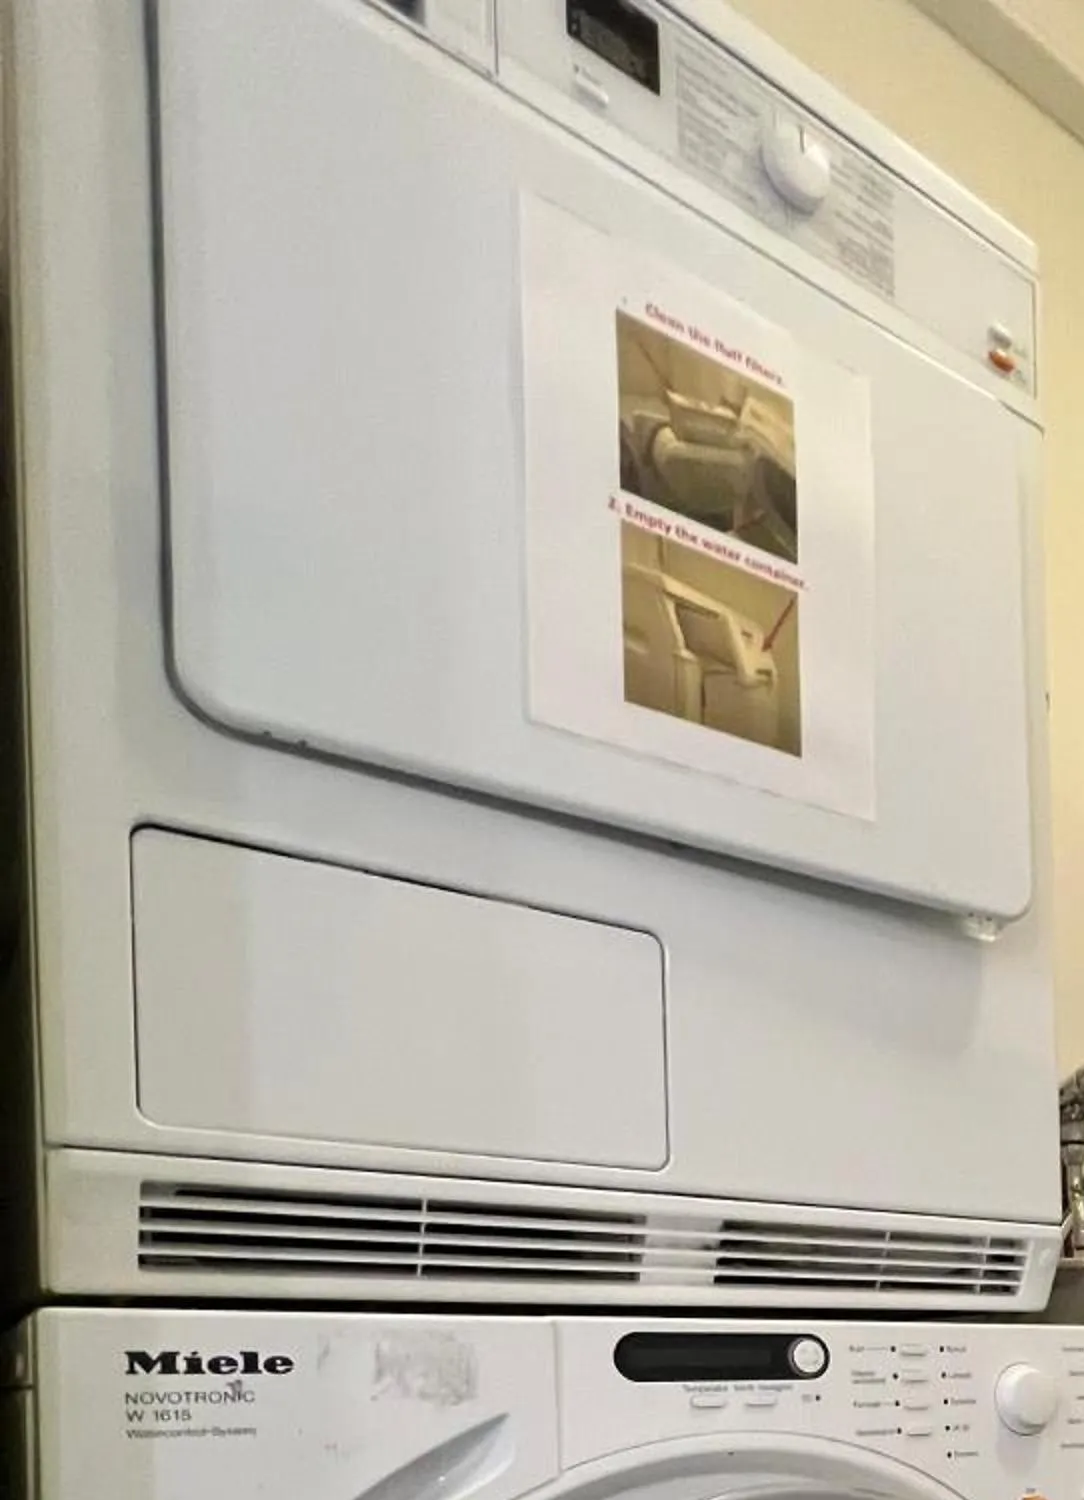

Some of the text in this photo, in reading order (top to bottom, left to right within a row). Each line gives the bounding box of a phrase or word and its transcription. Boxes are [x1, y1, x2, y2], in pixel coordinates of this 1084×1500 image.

[688, 325, 711, 347] the
[625, 502, 672, 535] Empty
[675, 525, 699, 545] the
[702, 537, 742, 563] water
[125, 1351, 295, 1374] Miele
[125, 1391, 255, 1404] NOVOTRONIC
[126, 1408, 192, 1422] W 1615
